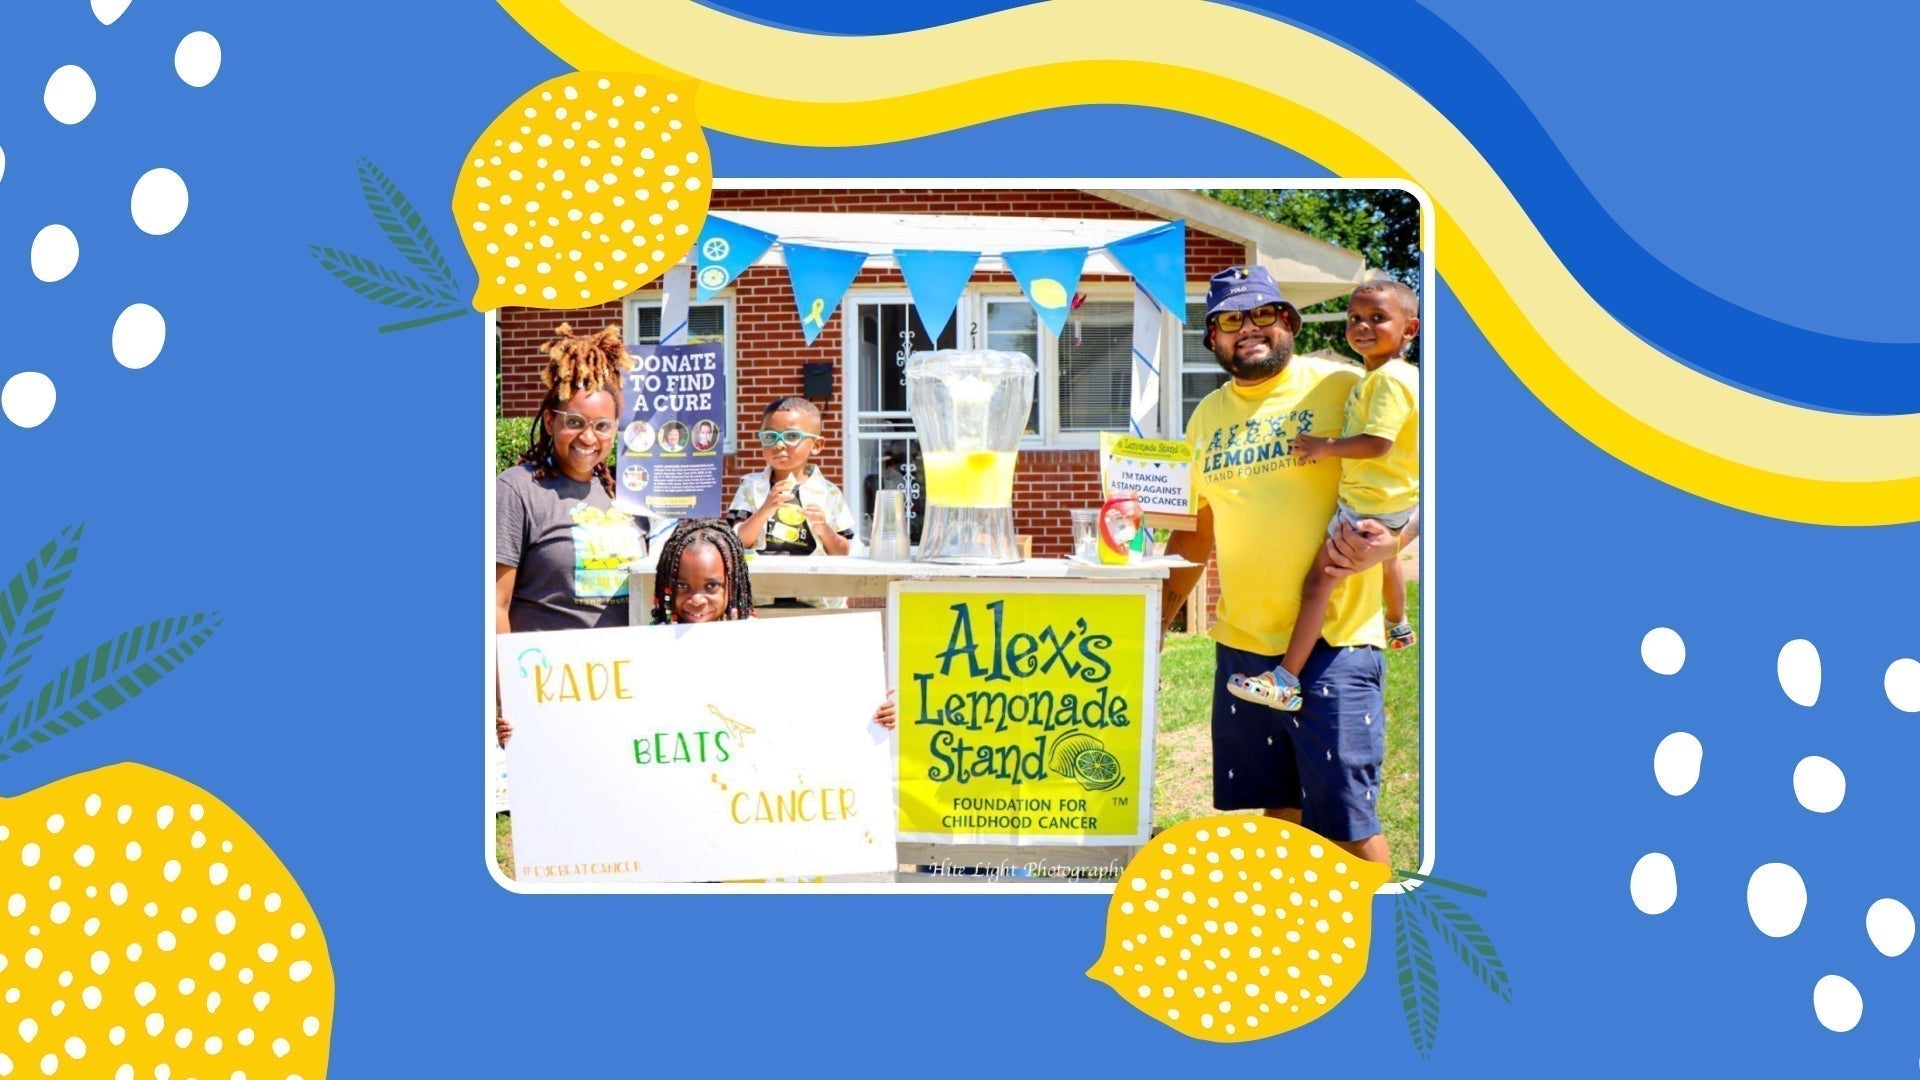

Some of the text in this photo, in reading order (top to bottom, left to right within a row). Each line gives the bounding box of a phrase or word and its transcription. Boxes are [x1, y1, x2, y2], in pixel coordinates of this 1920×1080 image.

[630, 352, 716, 372] DONATE
[630, 373, 715, 392] TO FIND
[633, 393, 711, 412] A CURE
[1122, 471, 1168, 484] I'M TAKING
[1111, 480, 1182, 495] A STAND AGAINST
[1152, 497, 1188, 507] CANCER
[936, 600, 1113, 683] Alex's
[535, 660, 634, 703] KADE
[913, 673, 1130, 733] Lemonade
[633, 731, 730, 764] BEATS
[928, 730, 1048, 785] Stand
[731, 788, 857, 824] CANCER
[953, 797, 1087, 812] FOUNDATION FOR
[1112, 797, 1129, 807] TM
[942, 815, 1098, 830] CHILDHOOD CANCER
